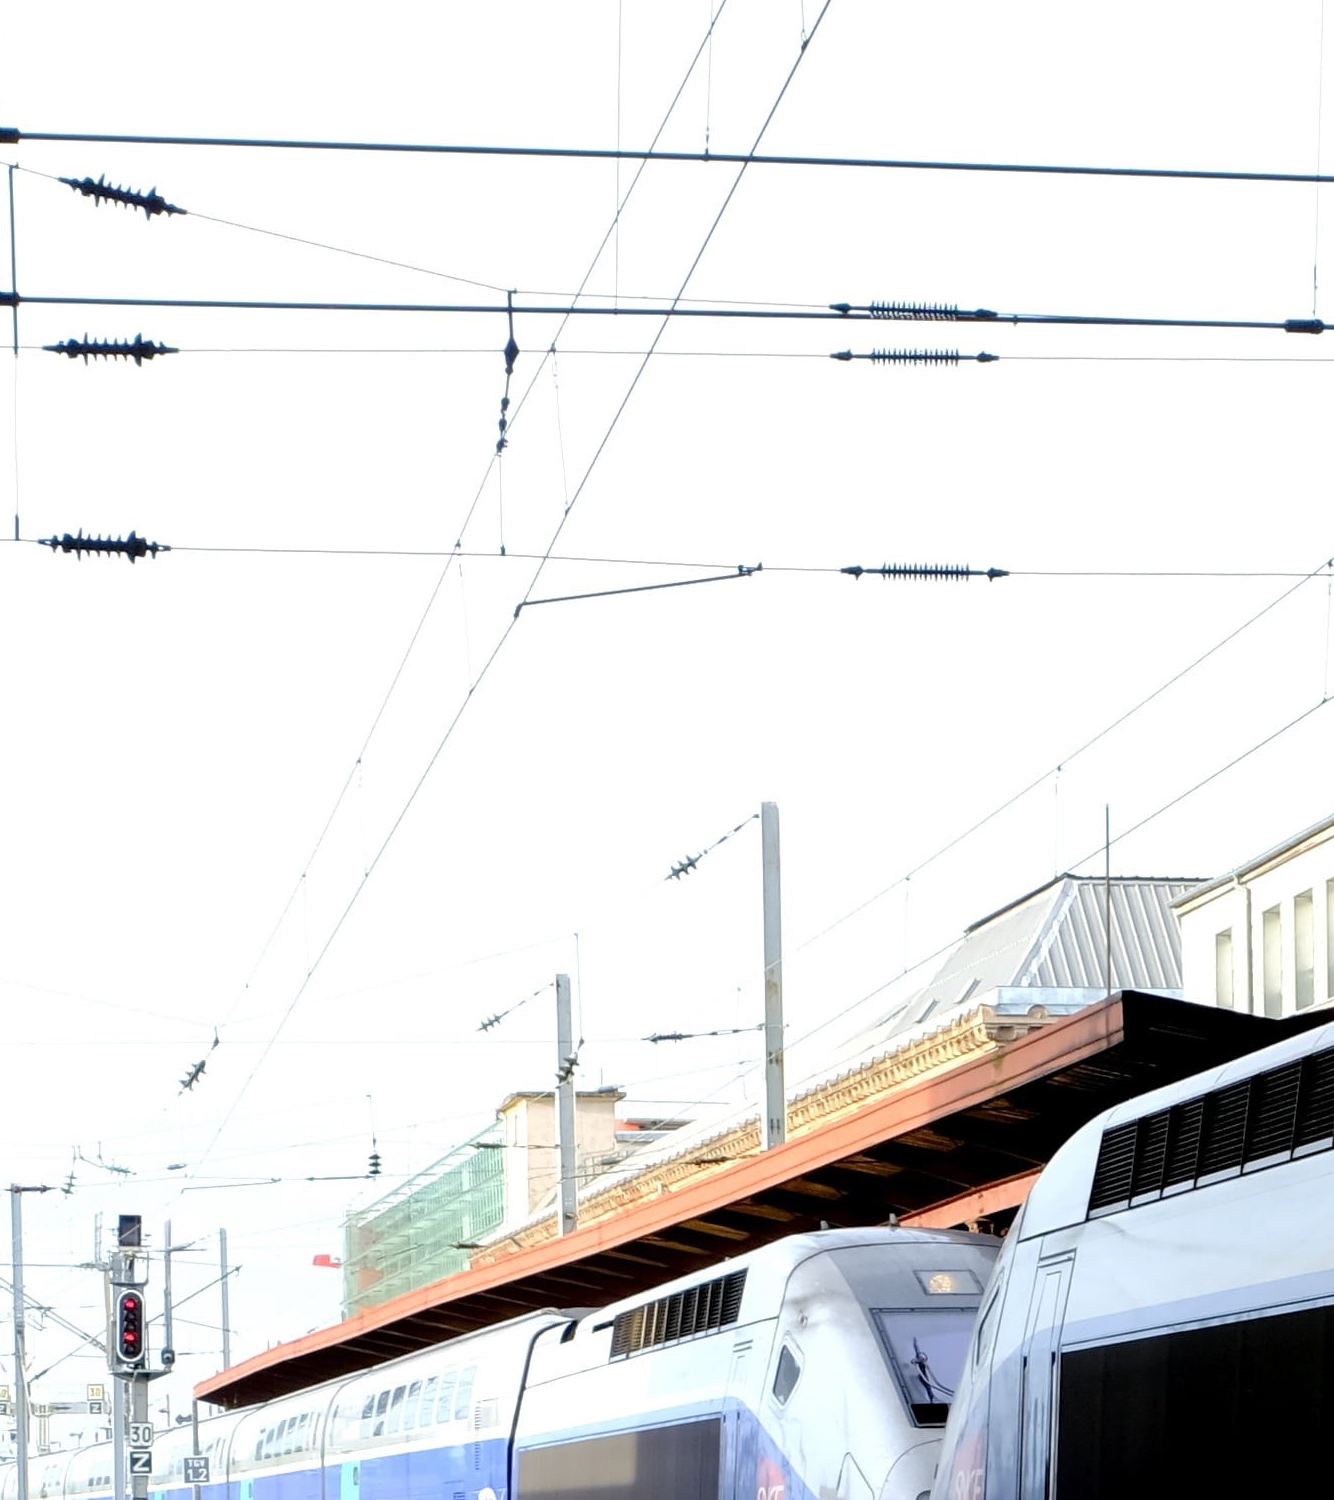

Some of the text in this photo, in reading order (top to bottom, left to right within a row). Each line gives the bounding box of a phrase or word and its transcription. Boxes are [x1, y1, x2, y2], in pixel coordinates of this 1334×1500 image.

[131, 1426, 151, 1443] 30
[132, 1452, 151, 1472] Z
[186, 1459, 206, 1468] TGV
